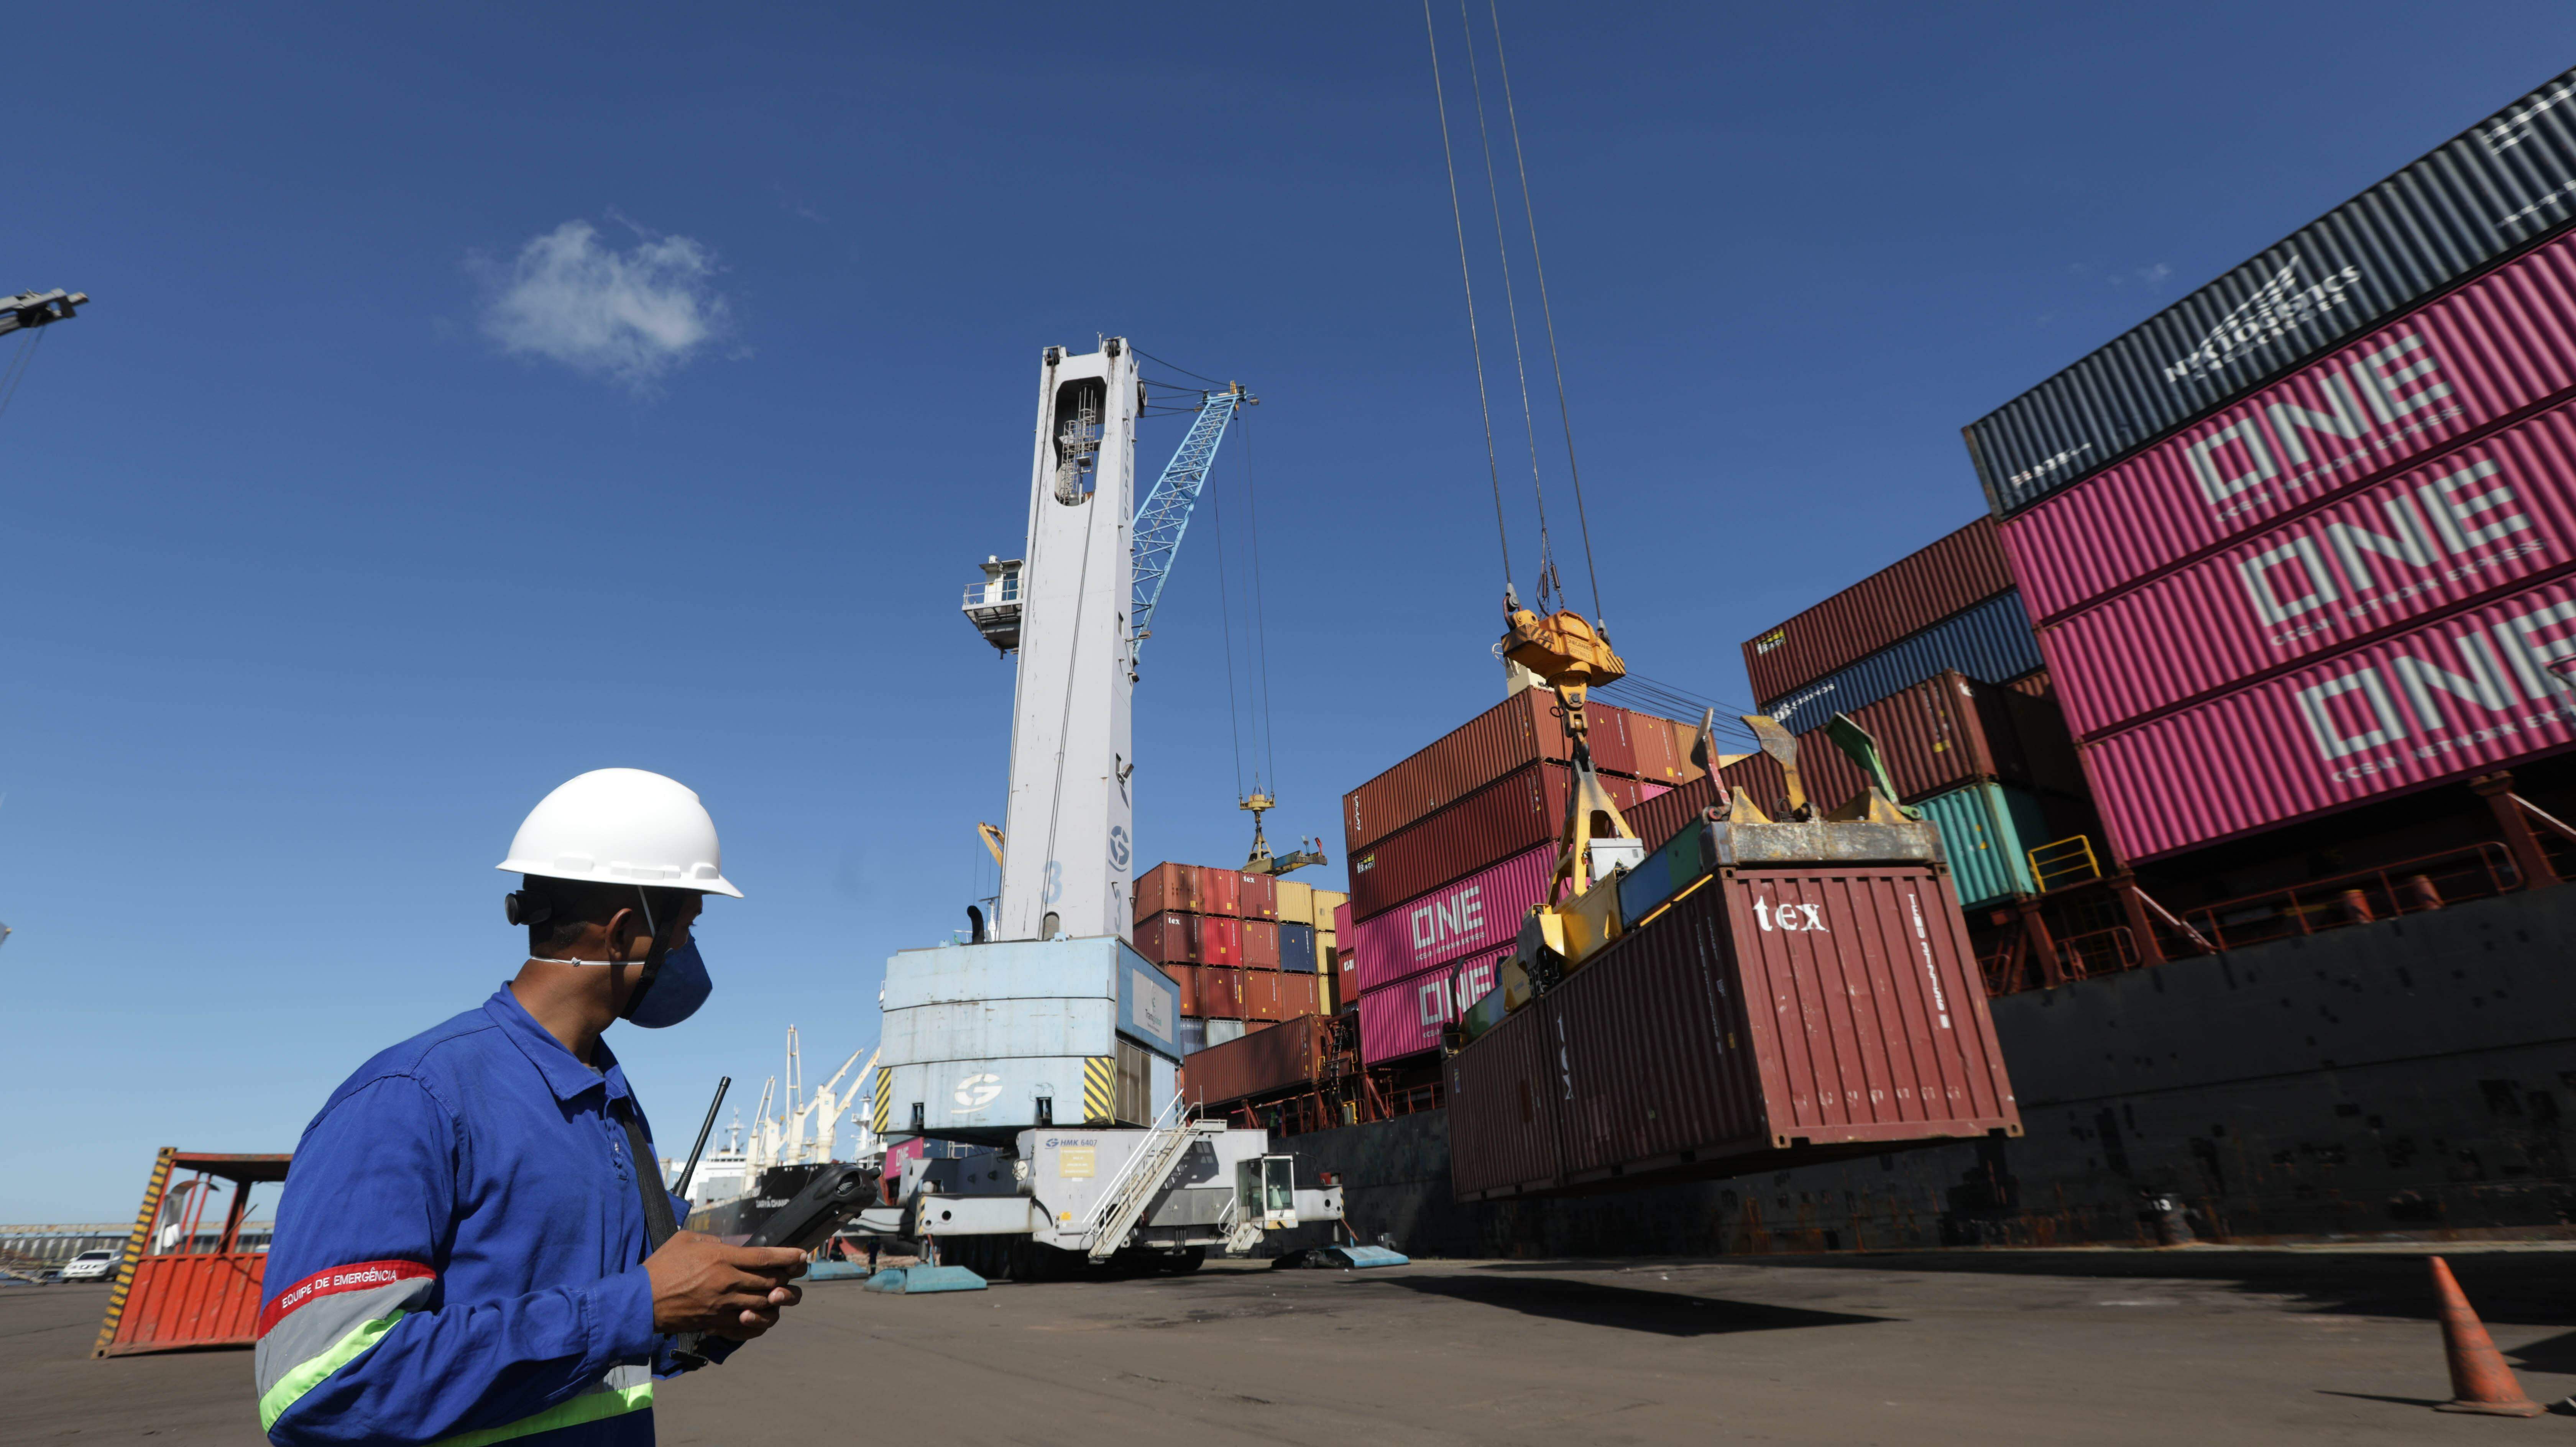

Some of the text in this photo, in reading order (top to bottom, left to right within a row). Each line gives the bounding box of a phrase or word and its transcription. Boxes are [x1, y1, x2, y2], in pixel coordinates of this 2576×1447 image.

[2184, 332, 2454, 505] ONE
[2216, 492, 2274, 523] OCEAN
[2238, 458, 2532, 627] ONE
[2270, 616, 2335, 646] OCEAN
[2331, 756, 2403, 783] OCEAN
[1040, 860, 1063, 904] 3
[1243, 875, 1255, 883] tex
[1114, 889, 1121, 932] 3
[1168, 917, 1180, 925] tex
[1411, 886, 1484, 950] ONE
[1753, 896, 1830, 933] tex
[1908, 894, 1925, 938] TEMU
[282, 1267, 397, 1309] EQUIPE DE EMERGÊNCIA
